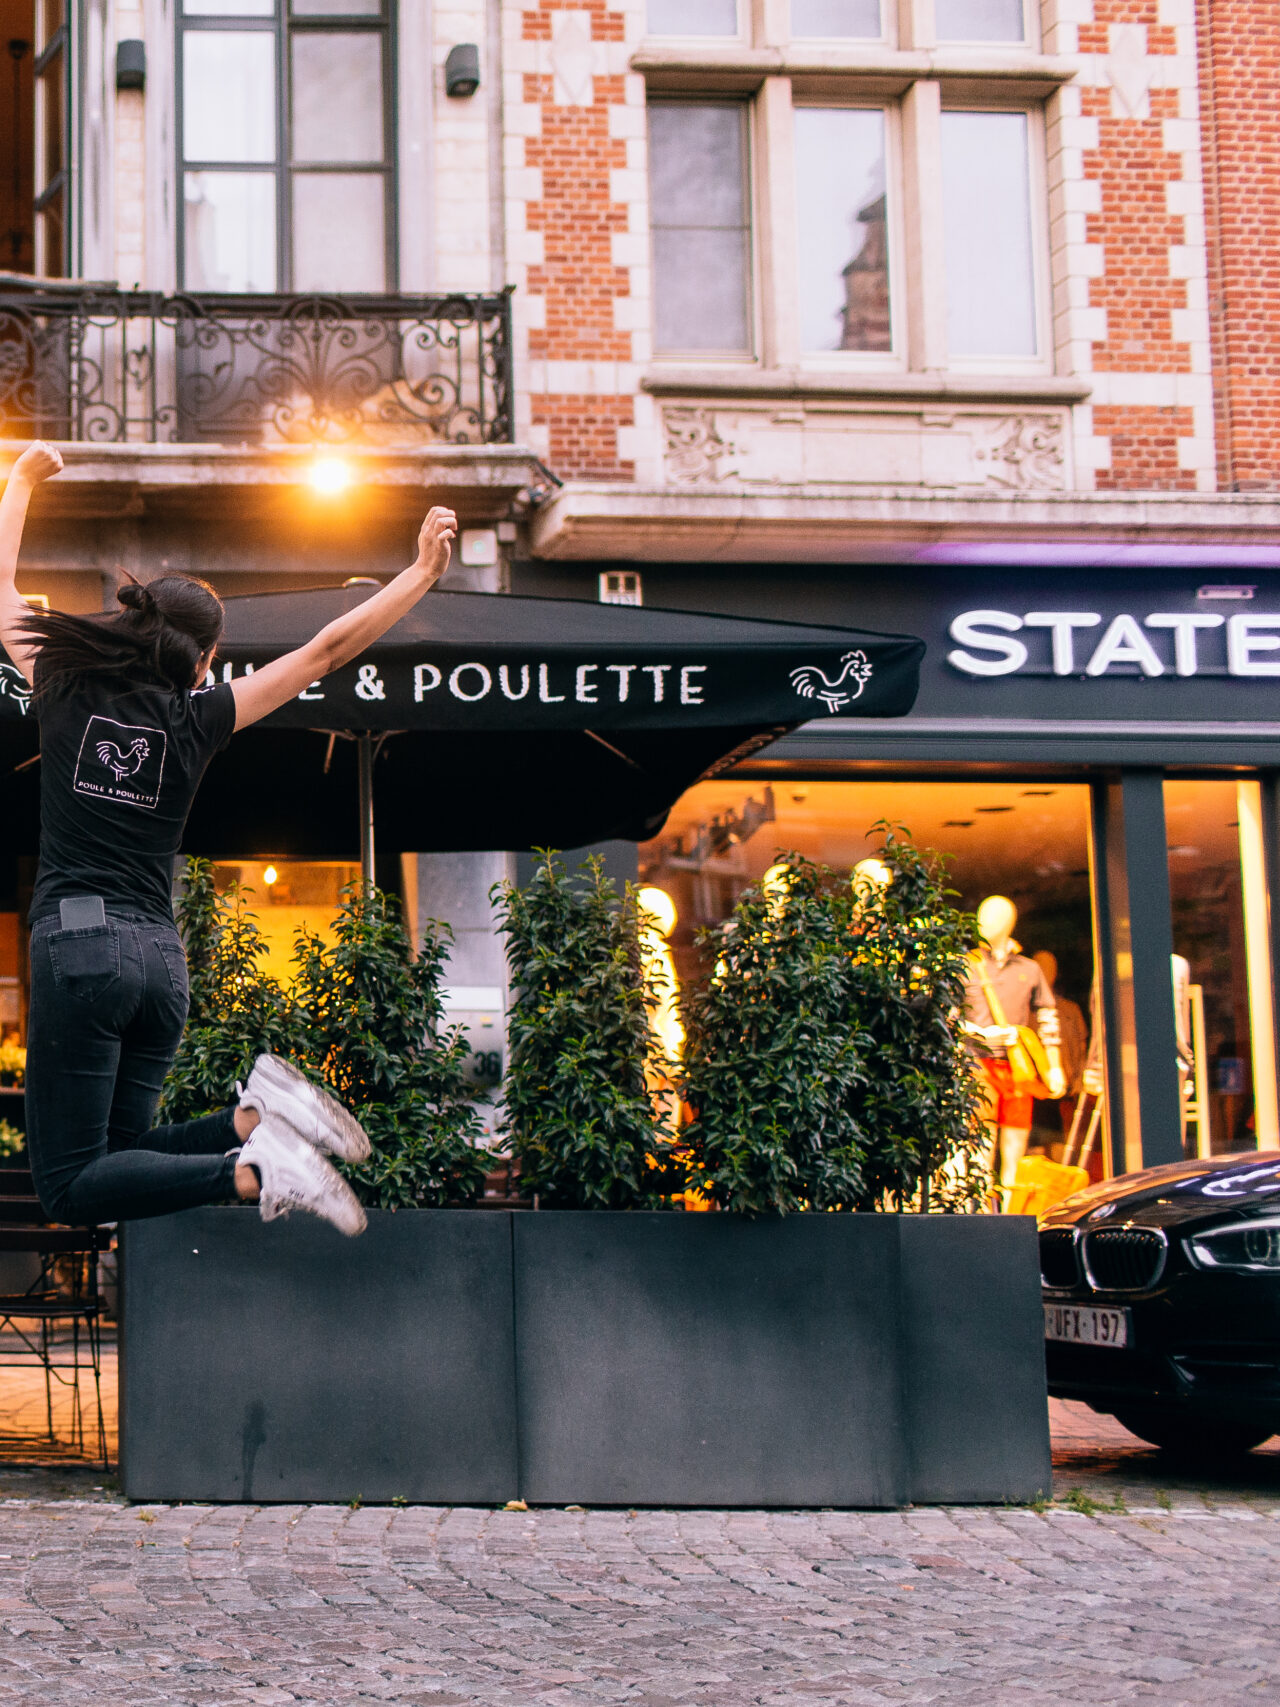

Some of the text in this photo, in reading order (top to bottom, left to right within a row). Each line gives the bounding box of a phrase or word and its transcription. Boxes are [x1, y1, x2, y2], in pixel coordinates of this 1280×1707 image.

[947, 610, 1280, 676] STATE
[355, 664, 387, 701] &
[413, 662, 708, 704] POULETTE
[78, 781, 104, 792] POULE
[116, 789, 154, 802] POULETTE
[473, 1050, 501, 1077] 36
